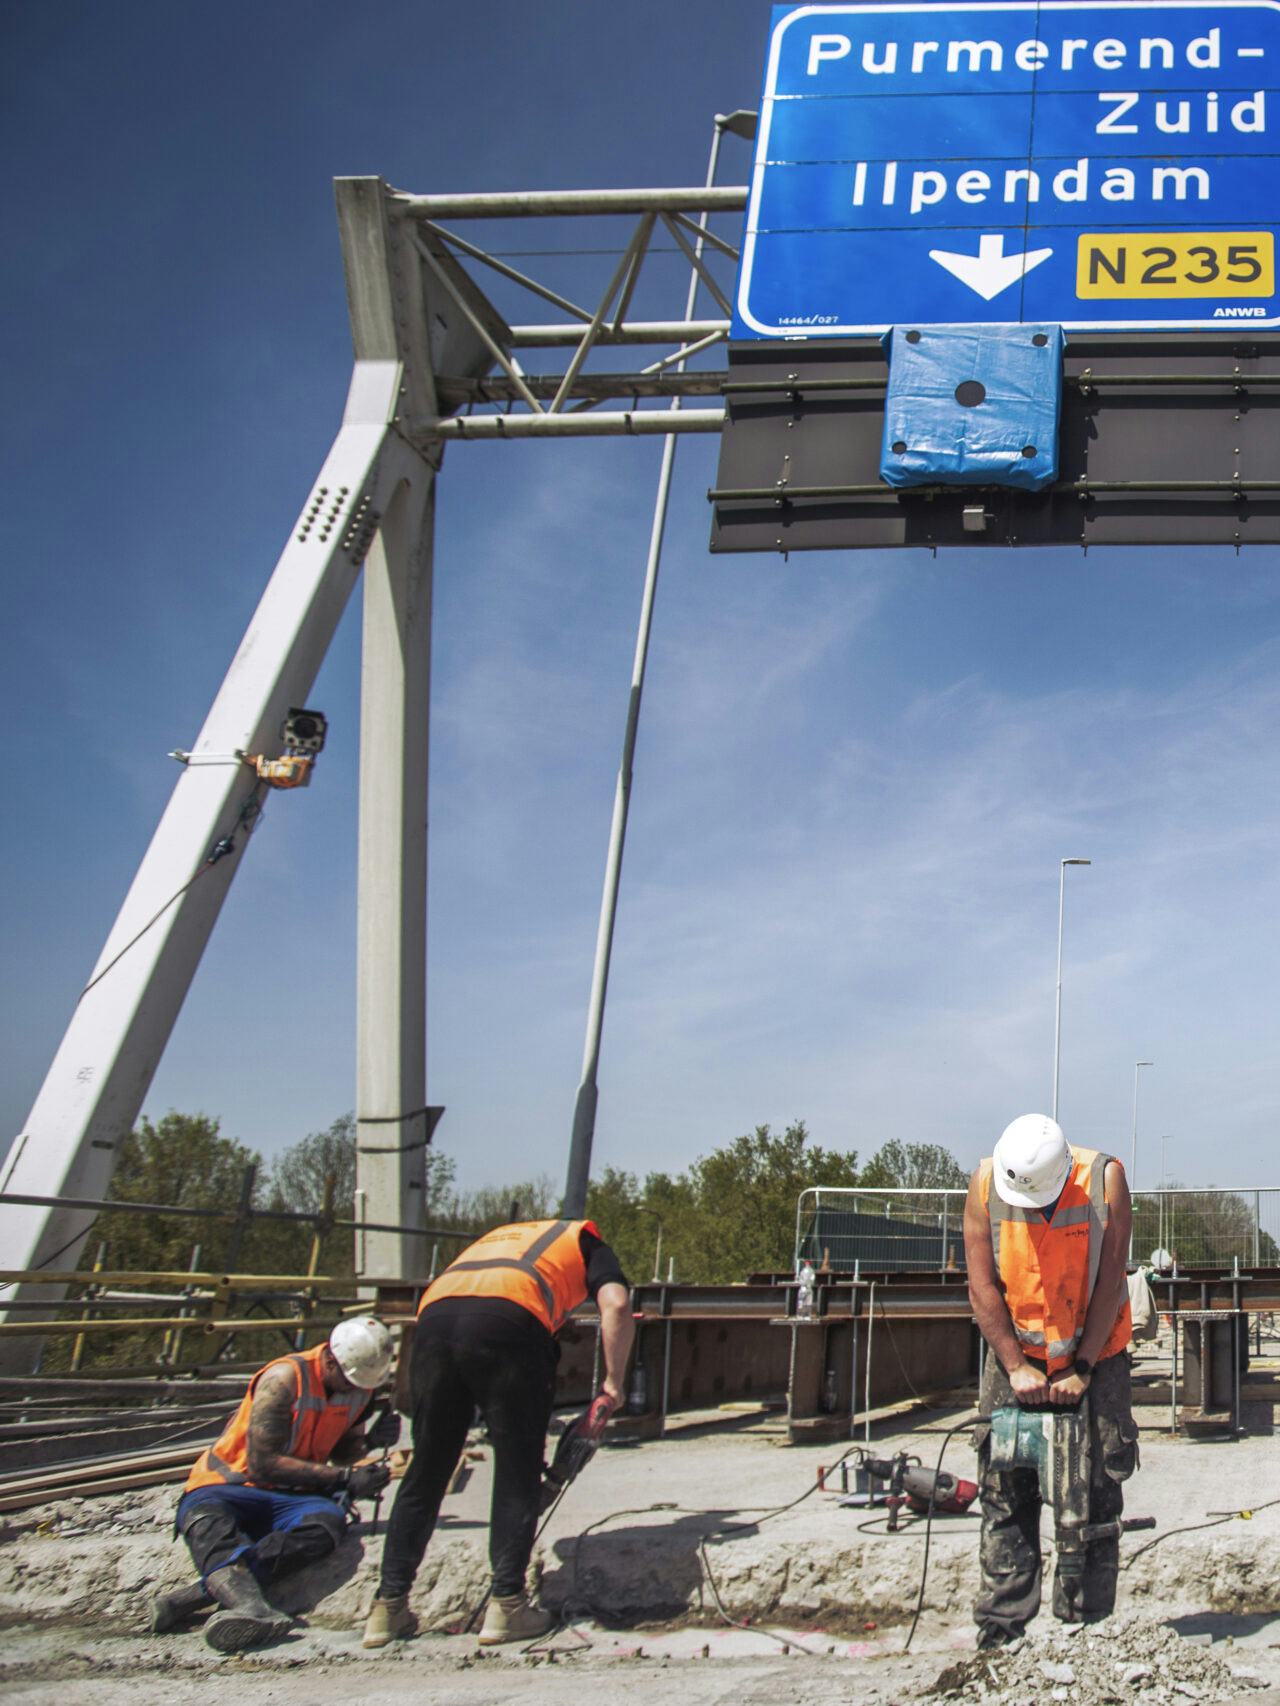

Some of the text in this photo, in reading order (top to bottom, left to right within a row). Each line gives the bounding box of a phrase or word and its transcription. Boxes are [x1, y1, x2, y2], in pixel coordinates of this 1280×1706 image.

[807, 27, 1264, 76] Purmerend-
[1096, 90, 1265, 134] Zuid
[852, 158, 1210, 214] Ilpendam
[1089, 246, 1262, 284] N235
[778, 314, 839, 325] 14464/027
[1213, 307, 1266, 317] ANWB
